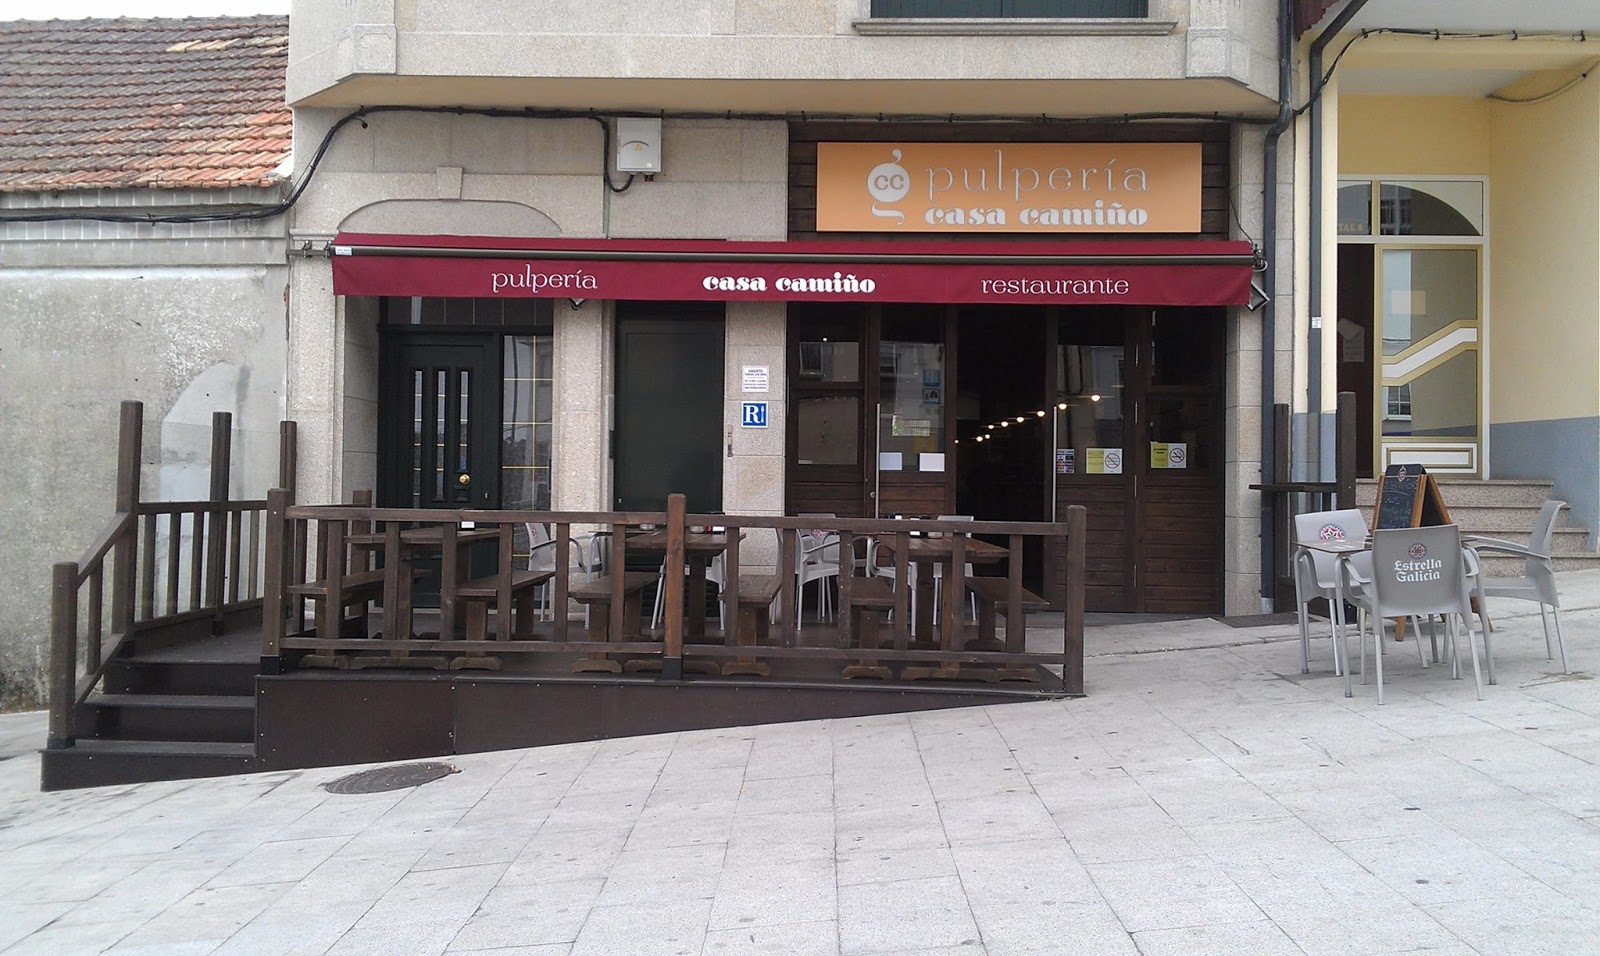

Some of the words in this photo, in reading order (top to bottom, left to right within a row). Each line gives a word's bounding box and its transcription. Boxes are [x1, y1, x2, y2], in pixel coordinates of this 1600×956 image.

[925, 149, 1150, 202] pulpería
[924, 207, 1008, 226] casa
[1019, 199, 1149, 226] camiño
[491, 264, 598, 294] pulpería
[702, 276, 768, 292] casa
[775, 271, 876, 294] camiño
[981, 277, 1130, 295] restaurante
[1394, 559, 1442, 571] Estrella
[1396, 570, 1440, 582] Galicia
